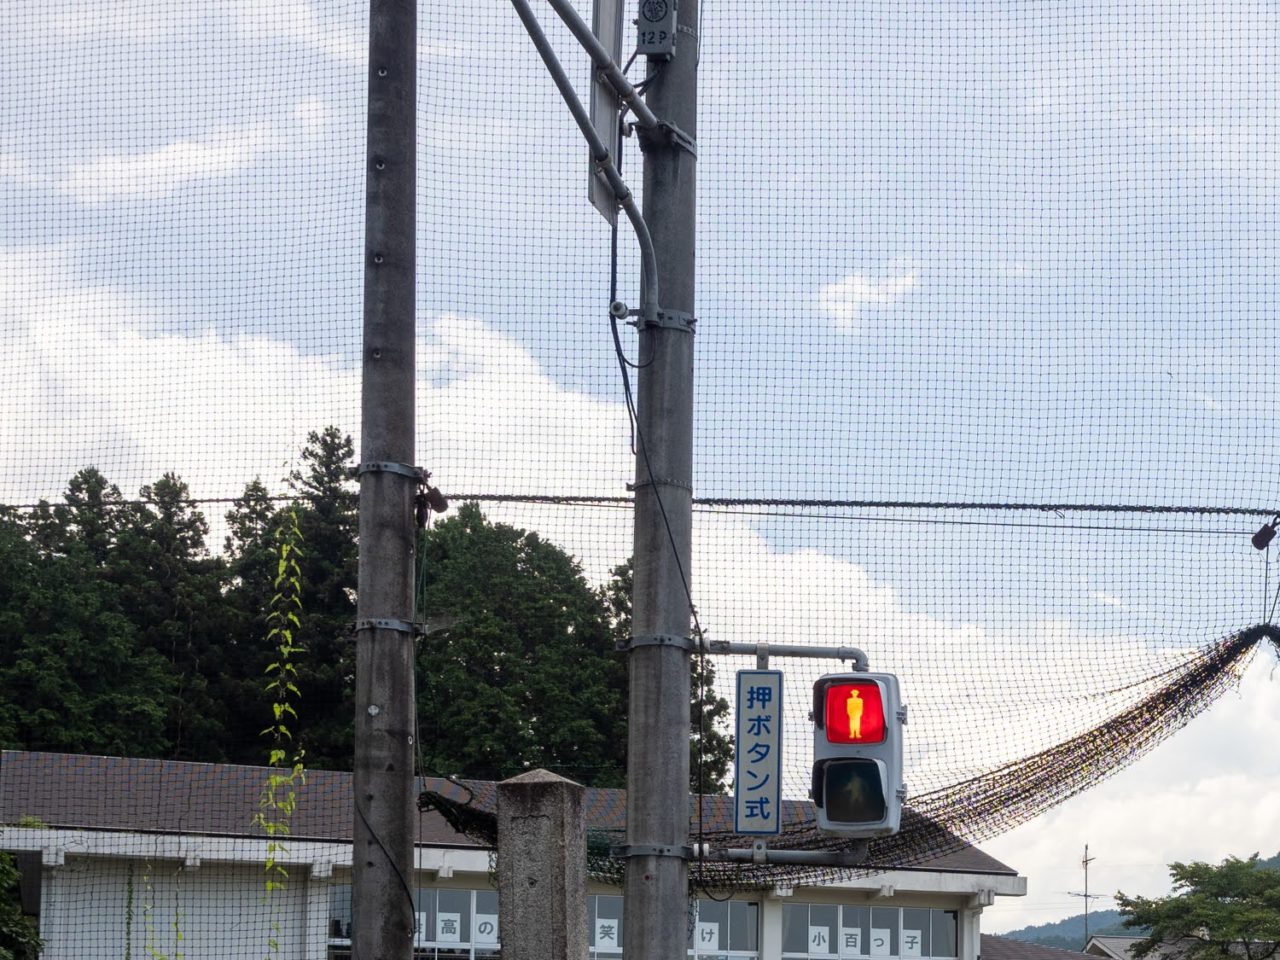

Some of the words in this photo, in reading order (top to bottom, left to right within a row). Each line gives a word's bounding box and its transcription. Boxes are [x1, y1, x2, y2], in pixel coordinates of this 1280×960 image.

[744, 686, 773, 821] 押ボタン式
